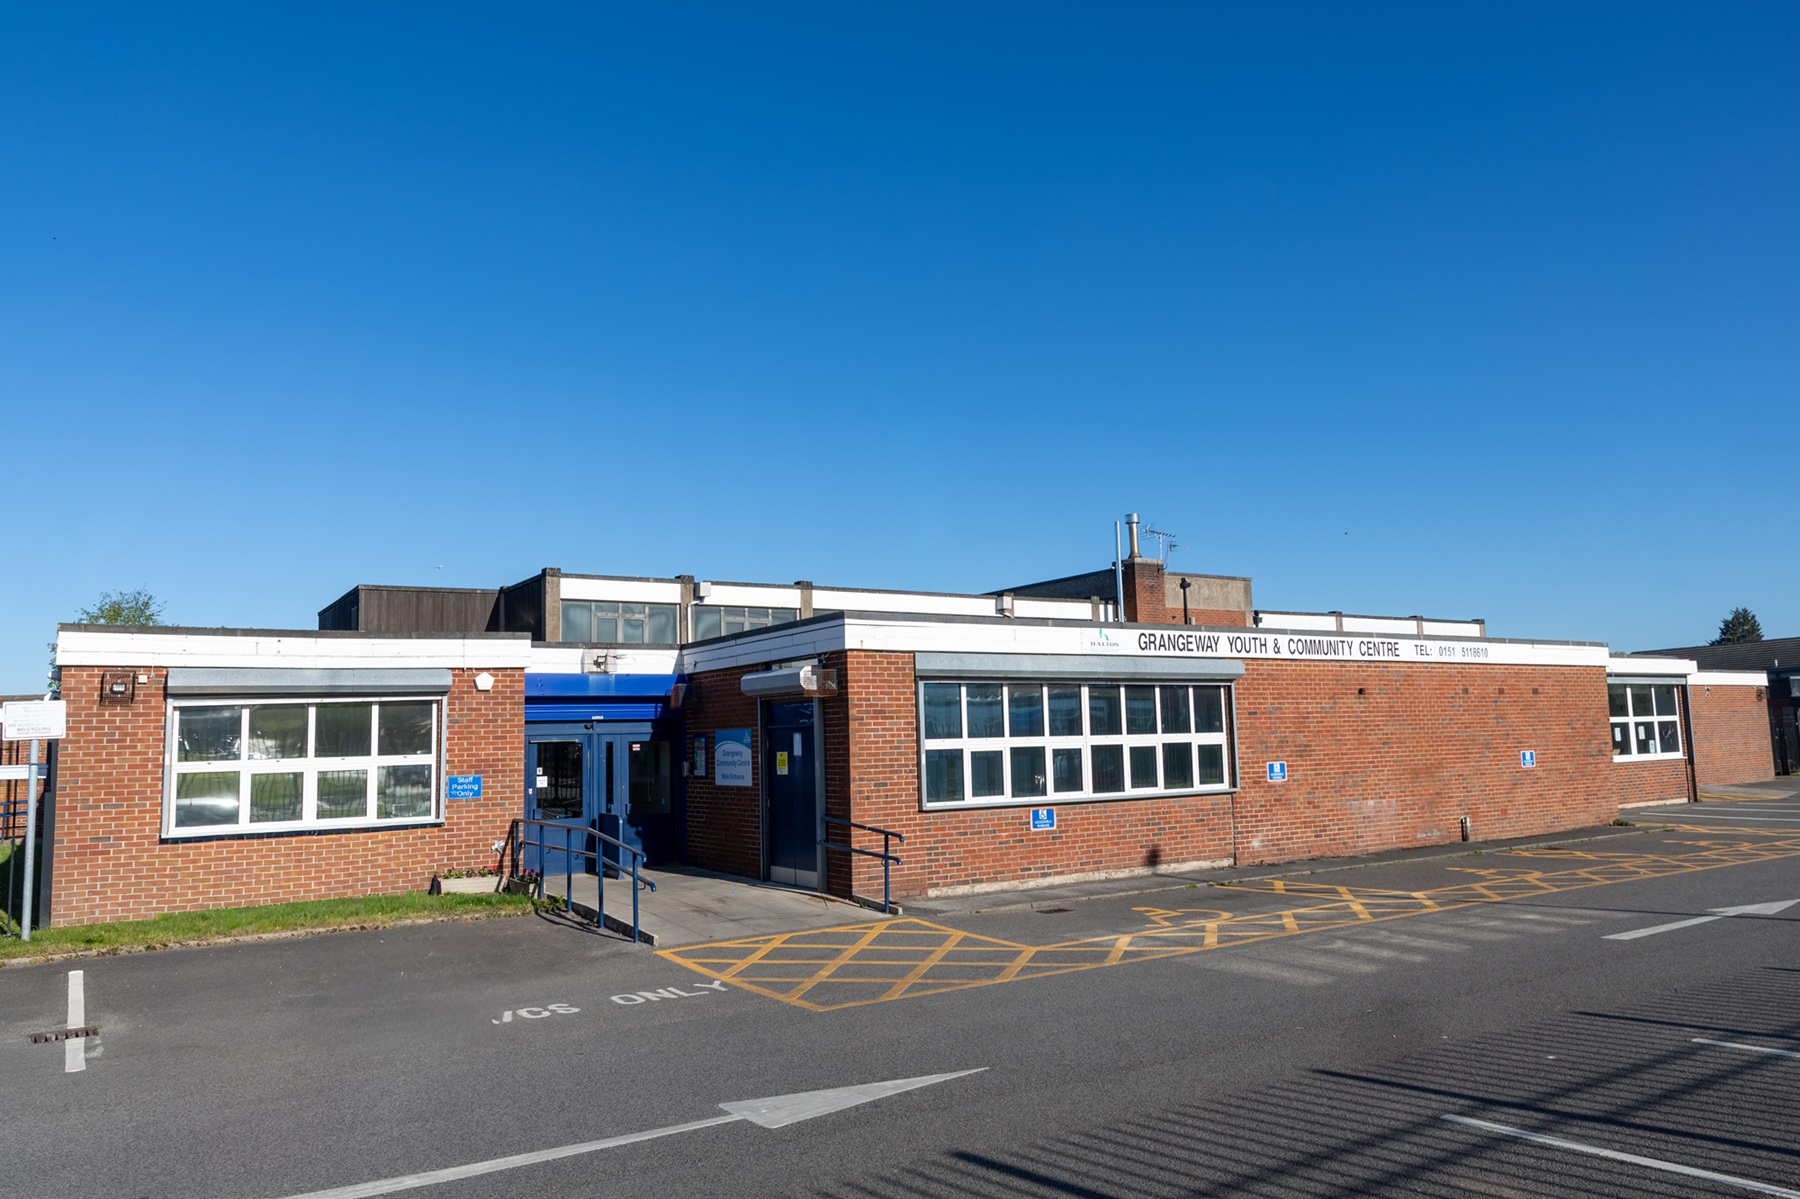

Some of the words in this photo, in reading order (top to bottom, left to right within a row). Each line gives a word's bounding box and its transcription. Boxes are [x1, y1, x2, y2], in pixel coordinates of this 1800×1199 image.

[1138, 632, 1220, 653] GRANGEWAY
[1227, 636, 1268, 654] YOUTH
[1273, 638, 1281, 654] &
[1287, 638, 1353, 656] COMMUNITY
[1359, 641, 1400, 657] CENTRE
[1414, 644, 1433, 656] TEL:
[1438, 646, 1455, 657] 0151
[1461, 647, 1489, 658] 5118610
[722, 749, 743, 758] Grangeway
[716, 759, 737, 768] Community
[737, 759, 750, 767] Centre
[451, 783, 478, 791] Parking
[610, 980, 729, 1005] ONLY
